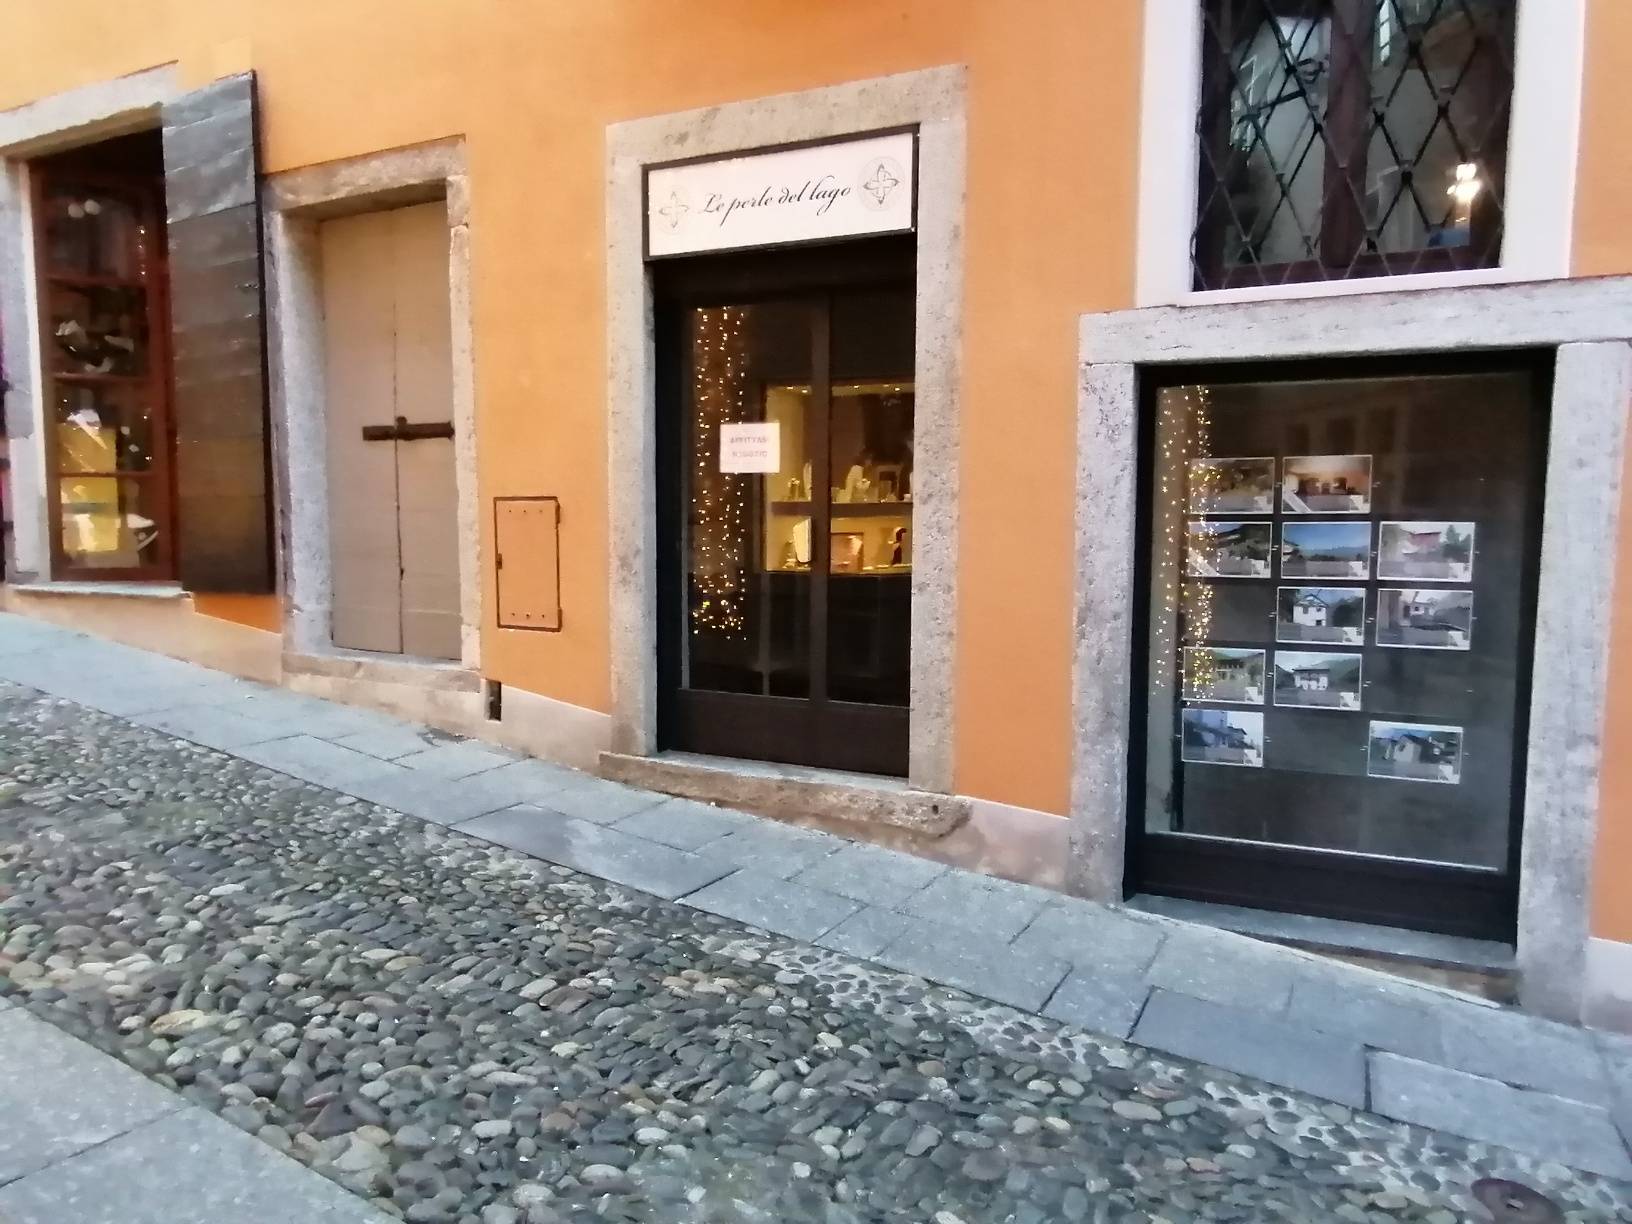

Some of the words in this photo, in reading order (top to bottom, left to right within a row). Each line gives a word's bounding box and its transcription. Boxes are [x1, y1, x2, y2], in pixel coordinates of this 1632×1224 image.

[703, 194, 725, 213] Le
[720, 186, 773, 226] perle
[778, 180, 809, 203] del
[809, 175, 851, 215] lago
